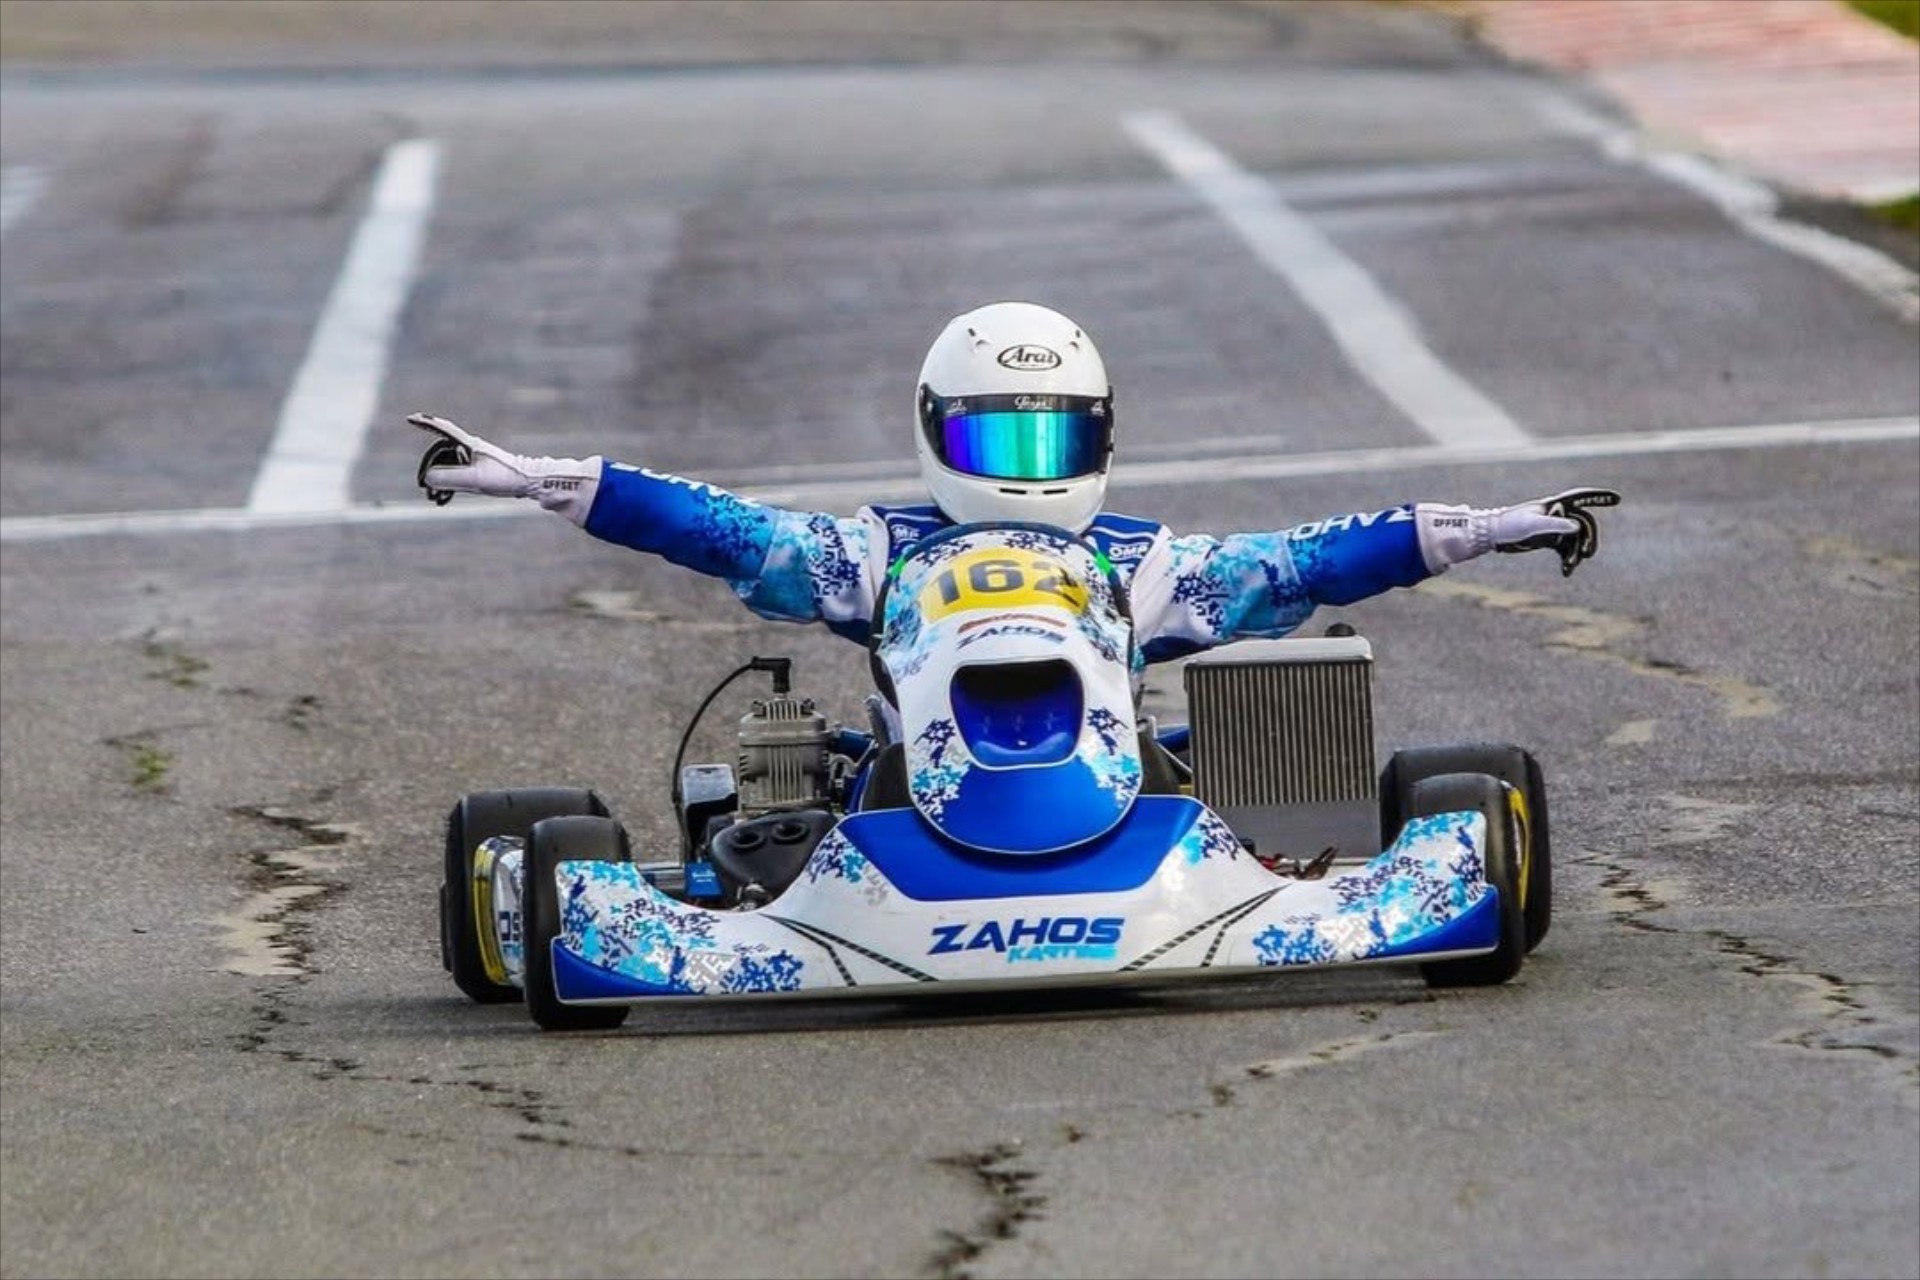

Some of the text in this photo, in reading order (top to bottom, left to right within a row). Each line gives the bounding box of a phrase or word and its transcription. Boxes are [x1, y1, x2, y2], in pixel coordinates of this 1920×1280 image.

[1003, 348, 1054, 363] Arai
[543, 479, 580, 491] OFFSET
[1434, 518, 1469, 528] OFFSET
[938, 559, 1080, 607] 162
[957, 625, 1068, 650] ZAHOS
[927, 917, 1126, 955] ZAHOS
